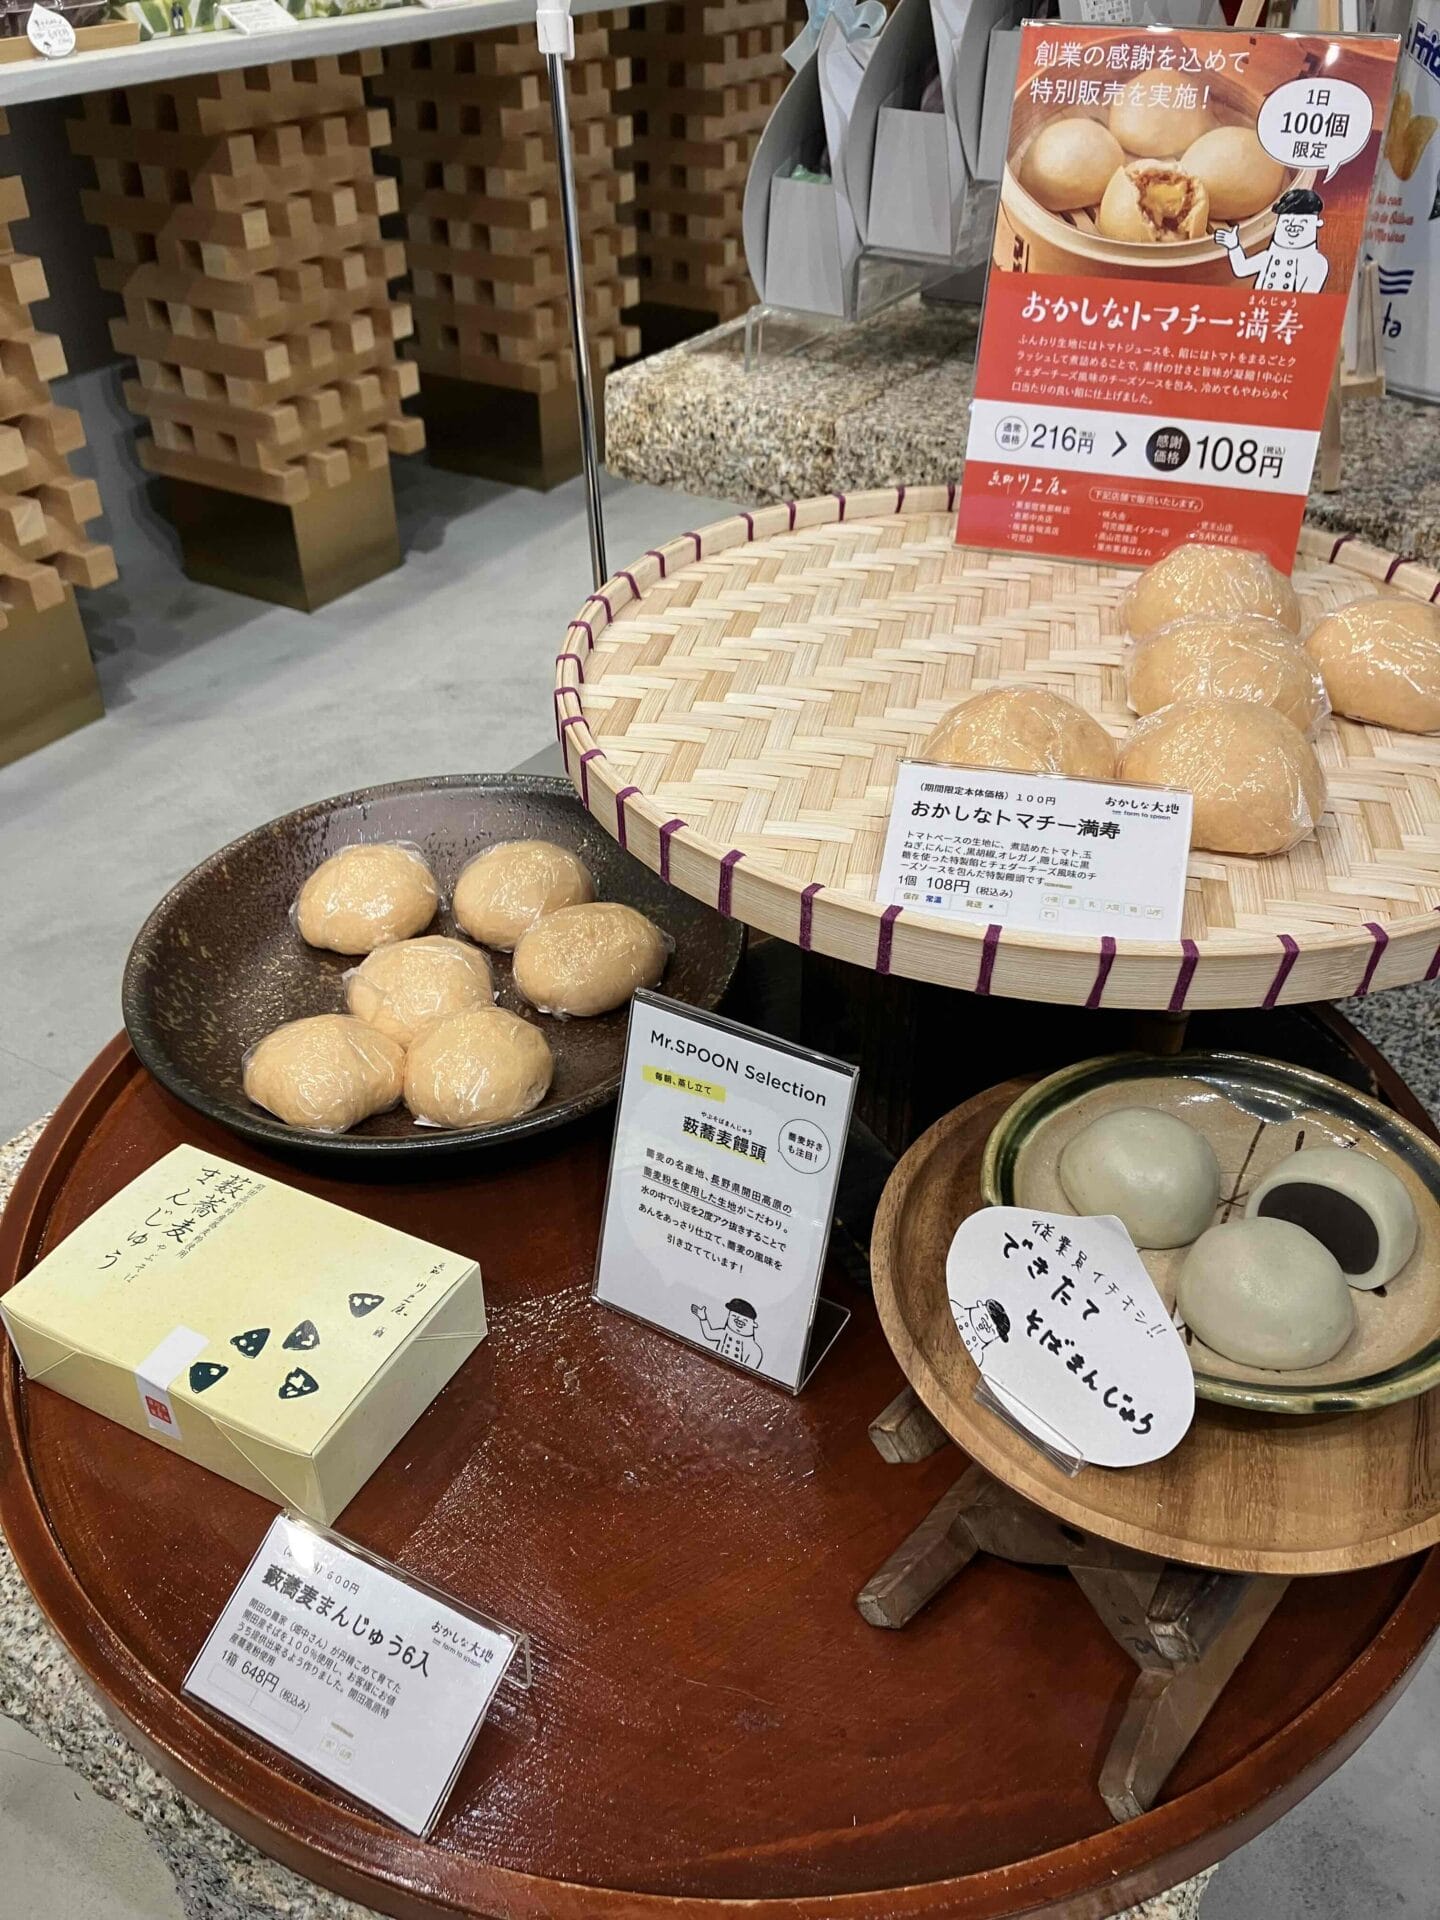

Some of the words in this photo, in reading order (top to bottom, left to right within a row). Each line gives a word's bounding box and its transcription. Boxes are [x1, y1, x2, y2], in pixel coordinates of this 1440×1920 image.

[1033, 40, 1250, 74] 創業の感謝を込めて
[1305, 88, 1331, 107] 1日
[1279, 111, 1350, 139] 100個
[1292, 141, 1328, 160] 限定
[1248, 294, 1298, 309] まんじゅう
[1021, 290, 1304, 345] おかしなトマチー満寿
[1001, 433, 1020, 445] 価格
[1003, 422, 1022, 433] 通常
[1030, 423, 1094, 455] 216円
[1155, 434, 1183, 450] 感謝
[1153, 449, 1180, 465] 価格
[1196, 435, 1284, 479] 108円
[910, 800, 1122, 840] おかしなトマチー満寿
[1104, 796, 1181, 815] おかしな大地
[897, 874, 918, 887] 1個
[926, 876, 971, 895] 108円
[925, 894, 942, 905] 常温
[649, 1029, 741, 1075] Mr.SPOON
[743, 1064, 827, 1107] Selection
[654, 1071, 712, 1096] 毎朝、蒸し立て
[700, 1111, 753, 1136] やぶそばまんじゅう
[787, 1131, 824, 1151] 蕎麦好き
[645, 1147, 793, 1215] 蕎麦の名産地、長野県開田高原の
[643, 1165, 789, 1234] 蕎麦粉を使用した生地がこだわり。
[640, 1184, 787, 1253] 水の中で小豆を2度アク抜きすることで
[638, 1203, 784, 1272] あんをあっさり仕立て、蕎麦の風味を
[1002, 1231, 1101, 1321] できたて
[1026, 1308, 1155, 1436] そばまんじゅう
[431, 1620, 494, 1664] おかしな大地
[220, 1650, 241, 1668] 1箱
[241, 1660, 280, 1694] 648円
